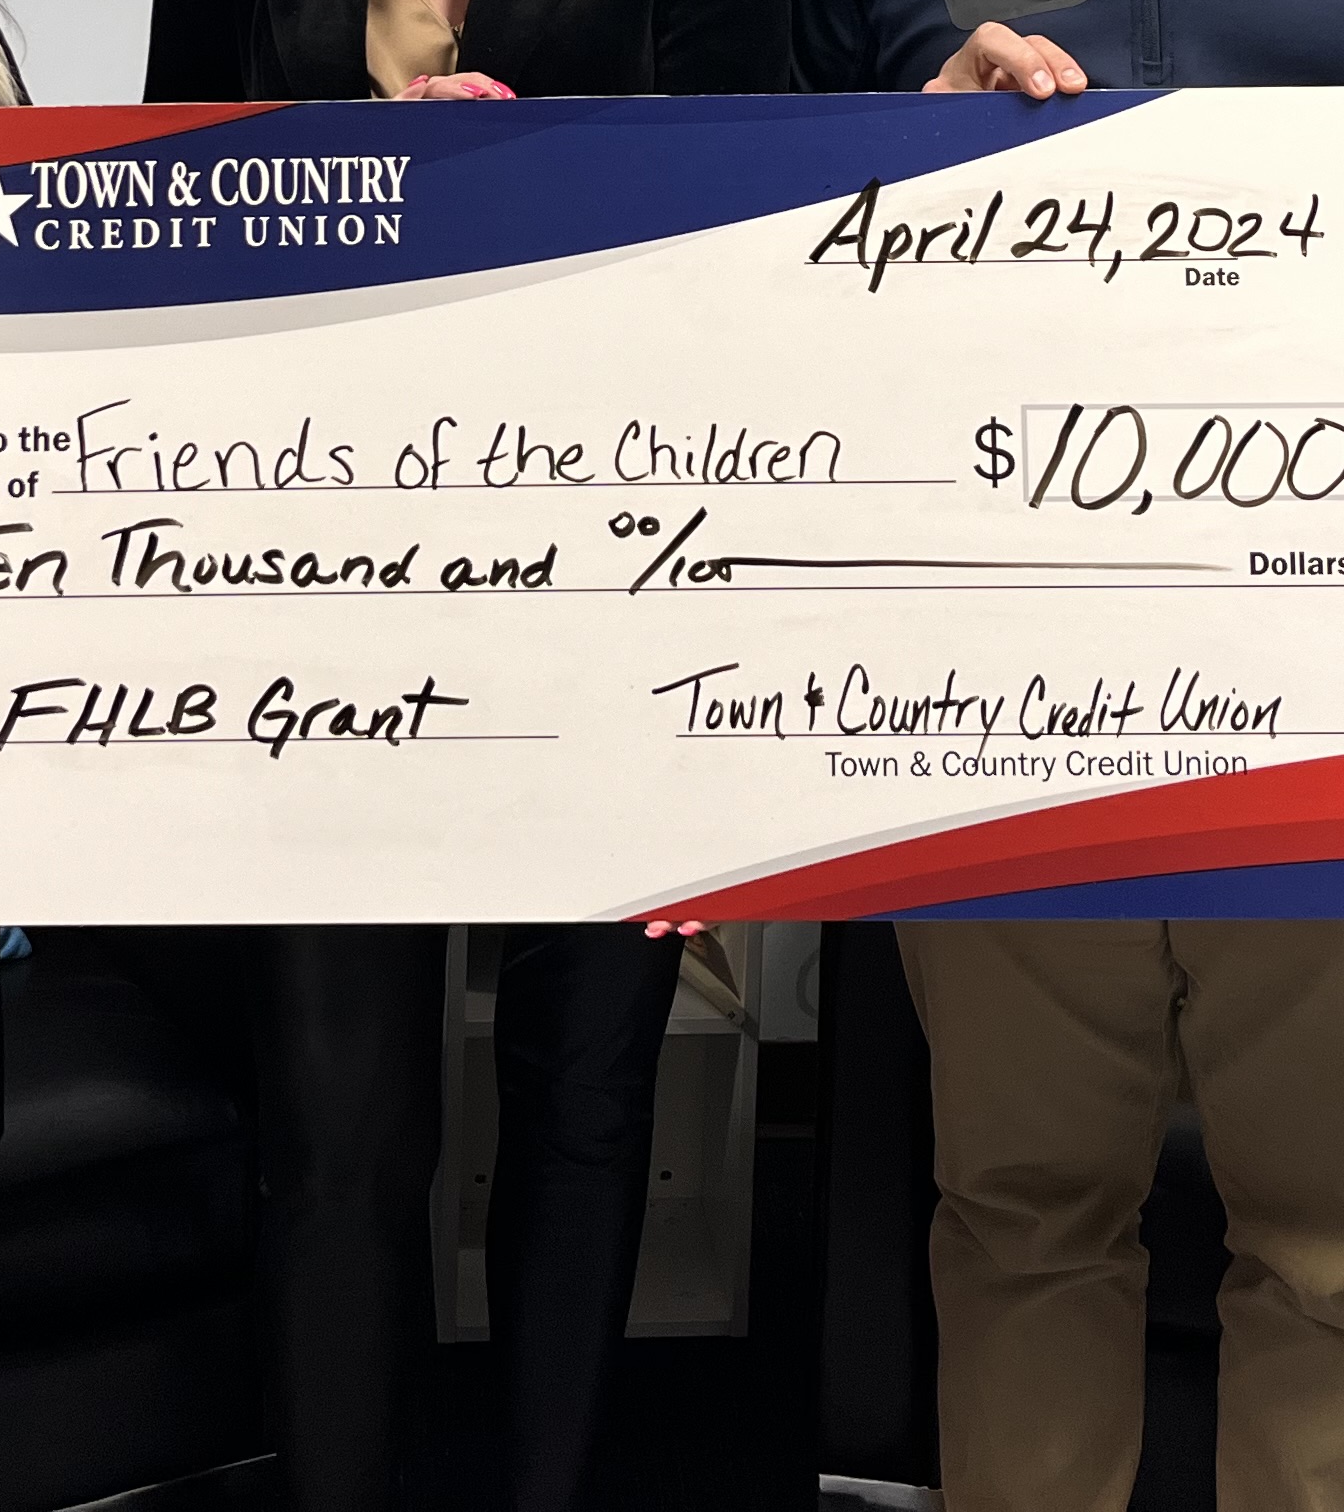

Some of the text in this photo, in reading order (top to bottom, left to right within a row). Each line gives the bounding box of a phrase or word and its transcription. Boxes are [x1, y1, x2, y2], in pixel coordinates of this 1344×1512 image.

[30, 155, 411, 210] TOWN & COUNTRY
[33, 212, 404, 252] CREDIT UNION
[809, 177, 1003, 294] April
[1184, 268, 1241, 288] Date
[16, 426, 72, 454] the
[76, 399, 842, 493] Friends of the Children
[6, 471, 40, 500] of
[101, 517, 422, 593] Thousand
[439, 543, 559, 593] and
[247, 675, 470, 760] Grant
[650, 661, 787, 741] Town
[836, 663, 1005, 769] Country
[1019, 673, 1145, 740] Credit
[1159, 666, 1283, 740] Union
[824, 749, 1249, 783] Town & Country Credit Union
